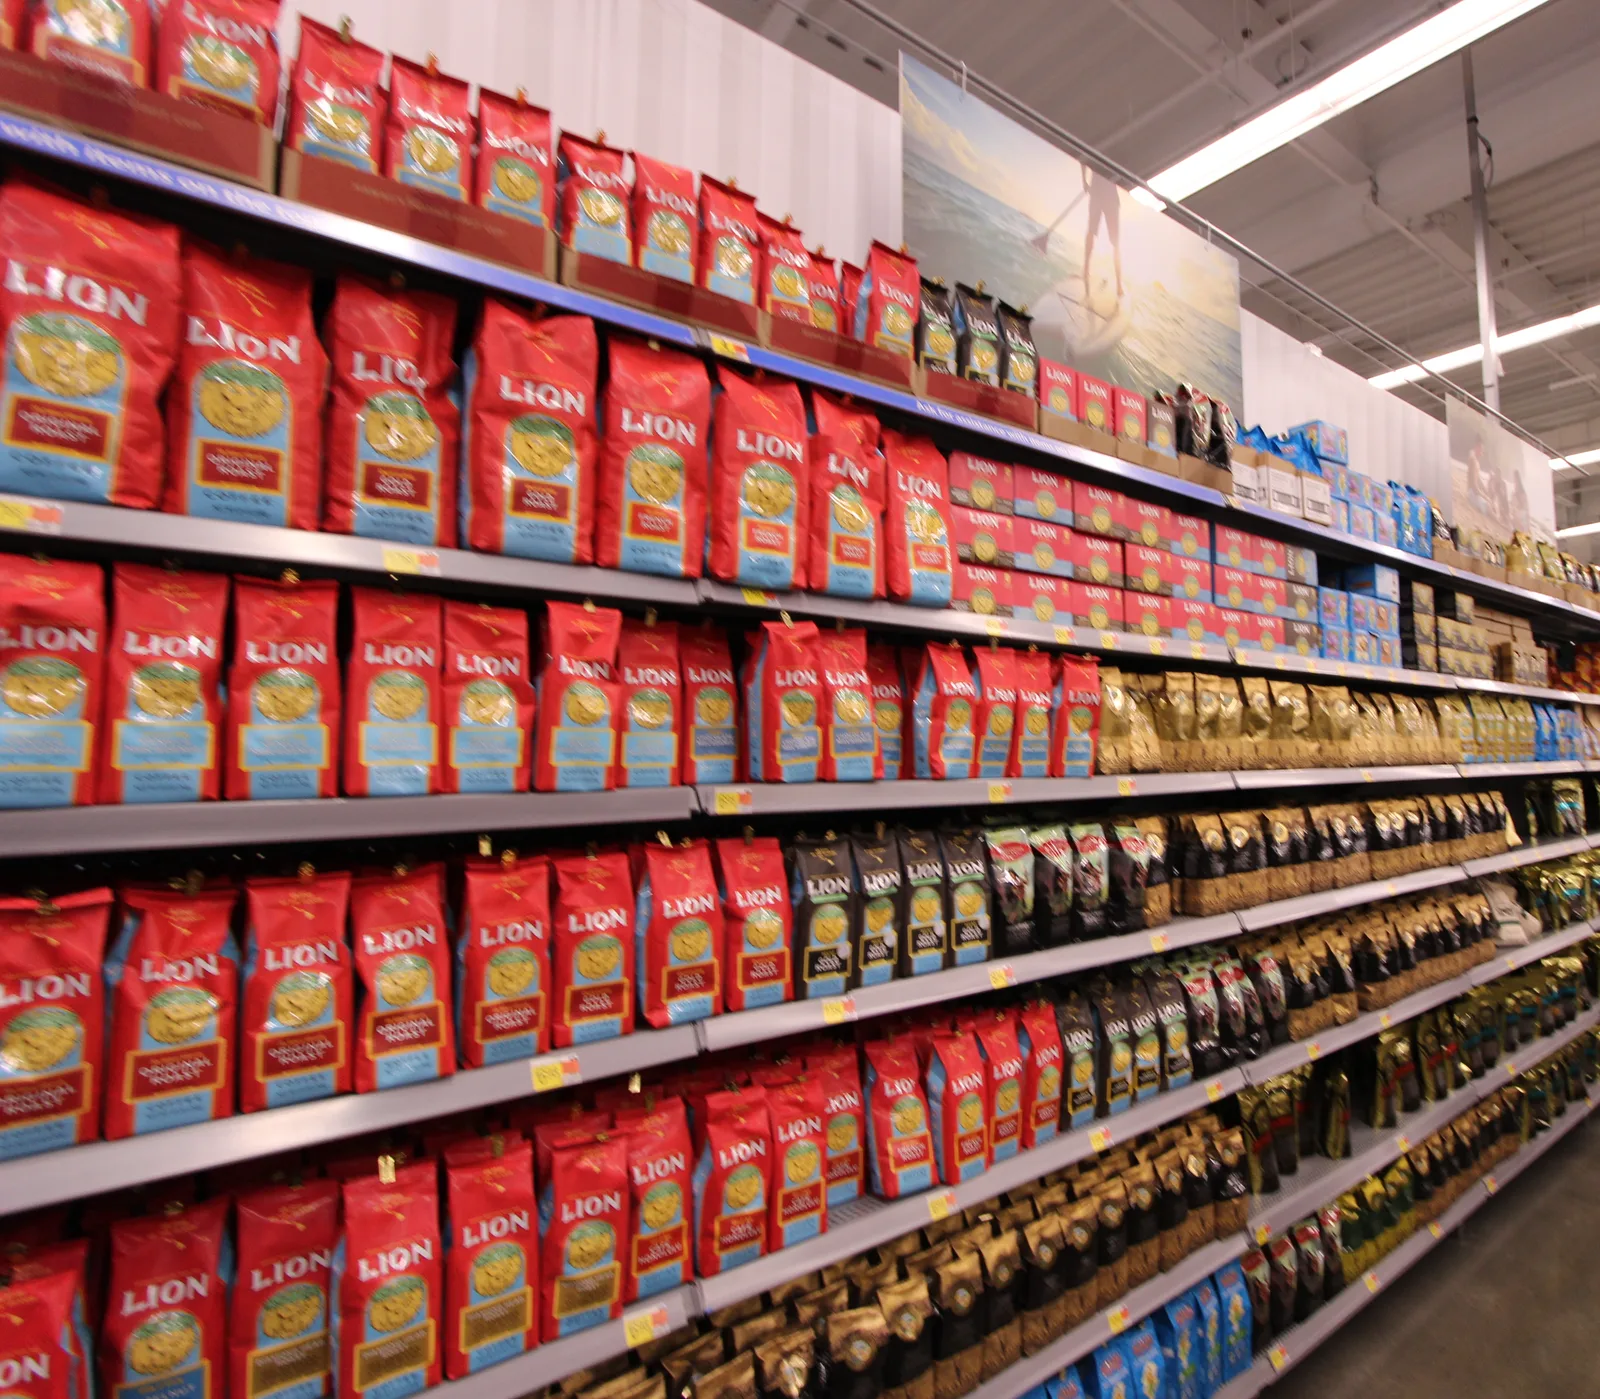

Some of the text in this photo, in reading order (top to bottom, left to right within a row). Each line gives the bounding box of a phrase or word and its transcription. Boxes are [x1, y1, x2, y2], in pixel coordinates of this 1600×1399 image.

[645, 184, 696, 218] LION
[768, 244, 810, 269] LION
[4, 258, 148, 326] LION
[809, 280, 838, 301] ION
[879, 277, 914, 309] LION
[966, 312, 999, 338] LION
[186, 316, 302, 364] LION
[1046, 366, 1072, 387] LION
[500, 374, 586, 417] LION
[1083, 380, 1108, 400] LION
[1120, 395, 1143, 412] LION
[1151, 406, 1173, 424] LION
[621, 407, 697, 446] LION
[737, 429, 804, 463] LION
[967, 456, 998, 476] LION
[897, 470, 942, 499] LION
[1031, 471, 1059, 488] LION
[1088, 486, 1112, 503] LION
[968, 511, 999, 529] LION
[1138, 503, 1160, 519] LION
[1030, 522, 1057, 540] LION
[1178, 515, 1199, 530] LION
[1086, 537, 1110, 553] LION
[1225, 529, 1243, 543] LION
[1260, 538, 1277, 551] LION
[1139, 548, 1161, 563] LION
[1181, 558, 1200, 572] LION
[1287, 545, 1296, 576] LION
[967, 566, 997, 583] LION
[1028, 576, 1056, 593] LION
[1225, 569, 1243, 583] LION
[1259, 577, 1277, 590] LION
[1085, 586, 1110, 600] LION
[1292, 584, 1310, 597] LION
[1138, 595, 1161, 609] LION
[1184, 602, 1205, 615] LION
[1222, 610, 1240, 623] LION
[1257, 616, 1275, 628] LION
[0, 624, 98, 652] LION
[1293, 622, 1310, 635] LION
[124, 631, 216, 659] LION
[245, 640, 328, 664] LION
[364, 642, 436, 667] LION
[456, 653, 520, 676] LION
[559, 655, 610, 680] LION
[624, 666, 677, 686] LION
[688, 667, 734, 684] LION
[775, 669, 818, 687] LION
[825, 669, 869, 687] LION
[872, 684, 902, 698] ION
[943, 680, 976, 697] LION
[986, 687, 1017, 704] LION
[1020, 688, 1052, 705] LION
[1068, 689, 1100, 706] LION
[906, 861, 942, 879] LION
[949, 859, 985, 876] LION
[806, 876, 850, 897] LION
[863, 871, 900, 892] LION
[662, 894, 715, 919] LION
[736, 886, 783, 908] LION
[568, 908, 628, 933] LION
[363, 924, 437, 955] LION
[480, 919, 543, 947] LION
[265, 940, 339, 970] LION
[140, 953, 220, 983] LION
[0, 972, 92, 1005] LION
[1156, 1001, 1187, 1022] LION
[1064, 1028, 1094, 1050] LION
[1035, 1046, 1060, 1067] LION
[993, 1057, 1022, 1080] LION
[951, 1072, 983, 1097] LION
[777, 1116, 822, 1143] LION
[718, 1138, 766, 1169] LION
[632, 1153, 685, 1186] LION
[561, 1191, 622, 1223] LION
[462, 1210, 530, 1248] LION
[251, 1249, 331, 1290] LION
[358, 1239, 433, 1282] LION
[121, 1273, 209, 1316] LION
[0, 1352, 50, 1389] ON
